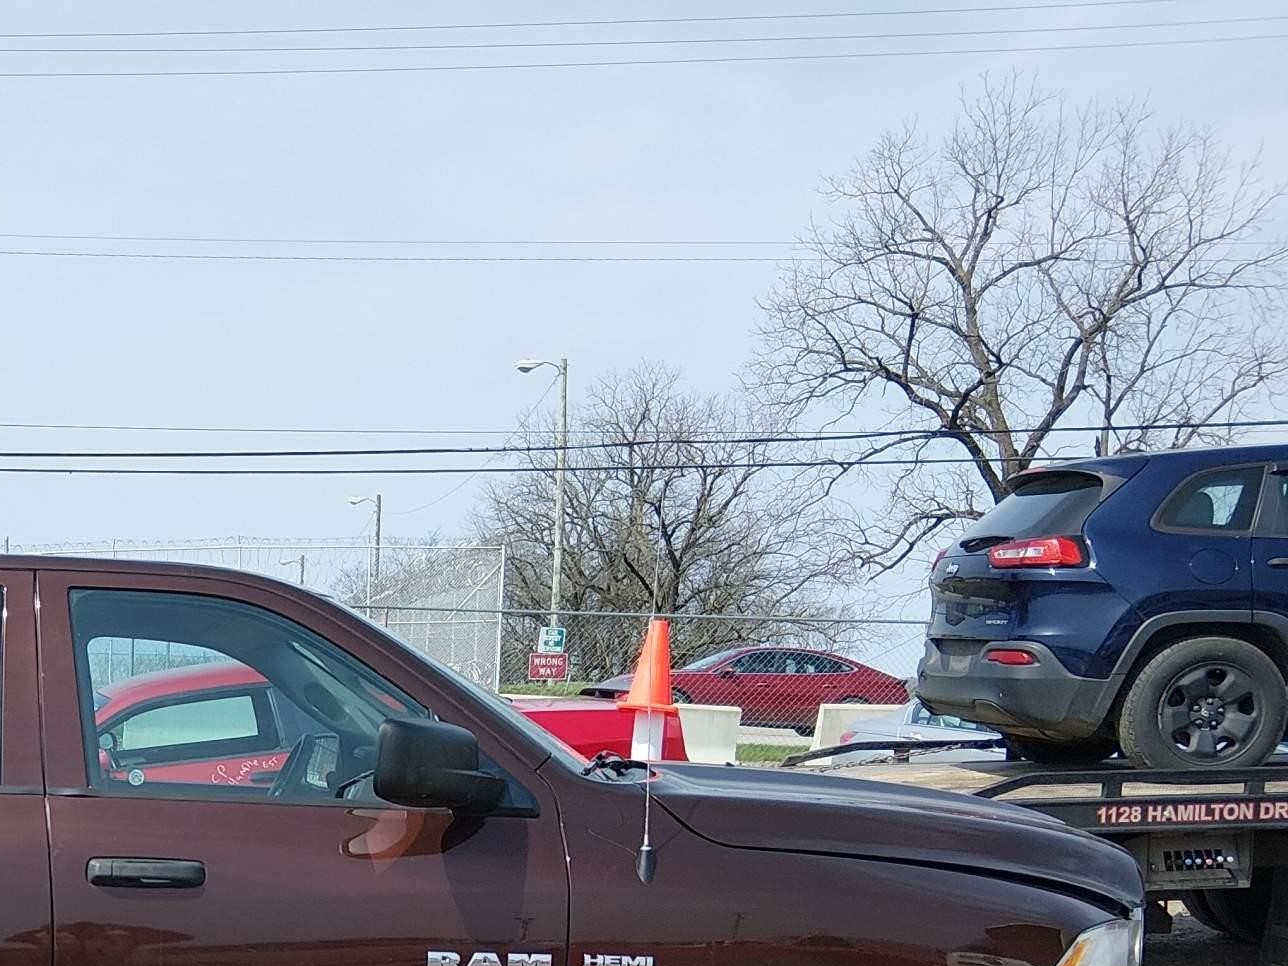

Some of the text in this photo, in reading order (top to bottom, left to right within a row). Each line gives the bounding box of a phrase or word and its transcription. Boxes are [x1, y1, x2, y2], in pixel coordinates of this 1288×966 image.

[533, 657, 563, 666] WRONG
[538, 667, 557, 676] WAY
[1097, 802, 1288, 824] 1128 HAMILTON DR
